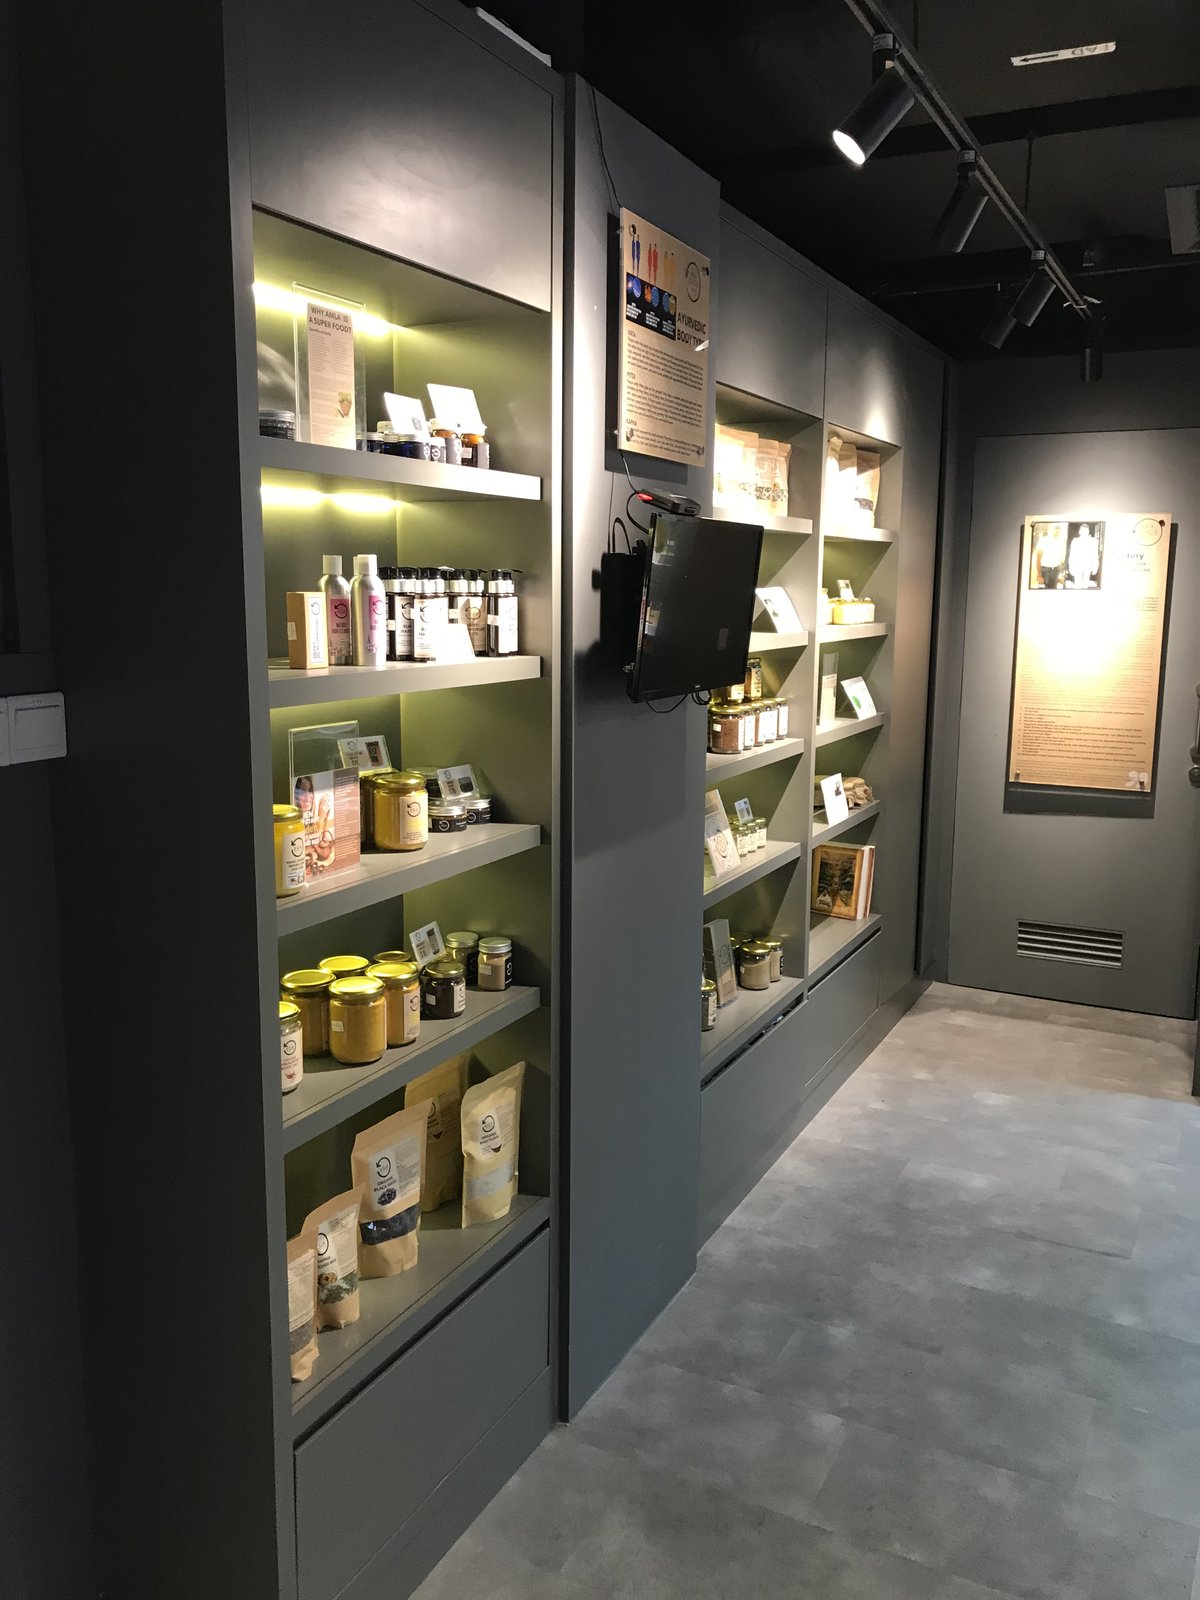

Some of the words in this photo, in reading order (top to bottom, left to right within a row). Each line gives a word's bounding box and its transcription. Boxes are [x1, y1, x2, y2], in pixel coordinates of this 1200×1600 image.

[310, 305, 325, 316] WHY
[325, 311, 341, 320] AMLA
[308, 316, 314, 324] A
[313, 317, 332, 328] SUPER
[332, 322, 352, 334] FOOD?
[677, 311, 707, 335] AYURVEDIC
[677, 329, 692, 345] BODY
